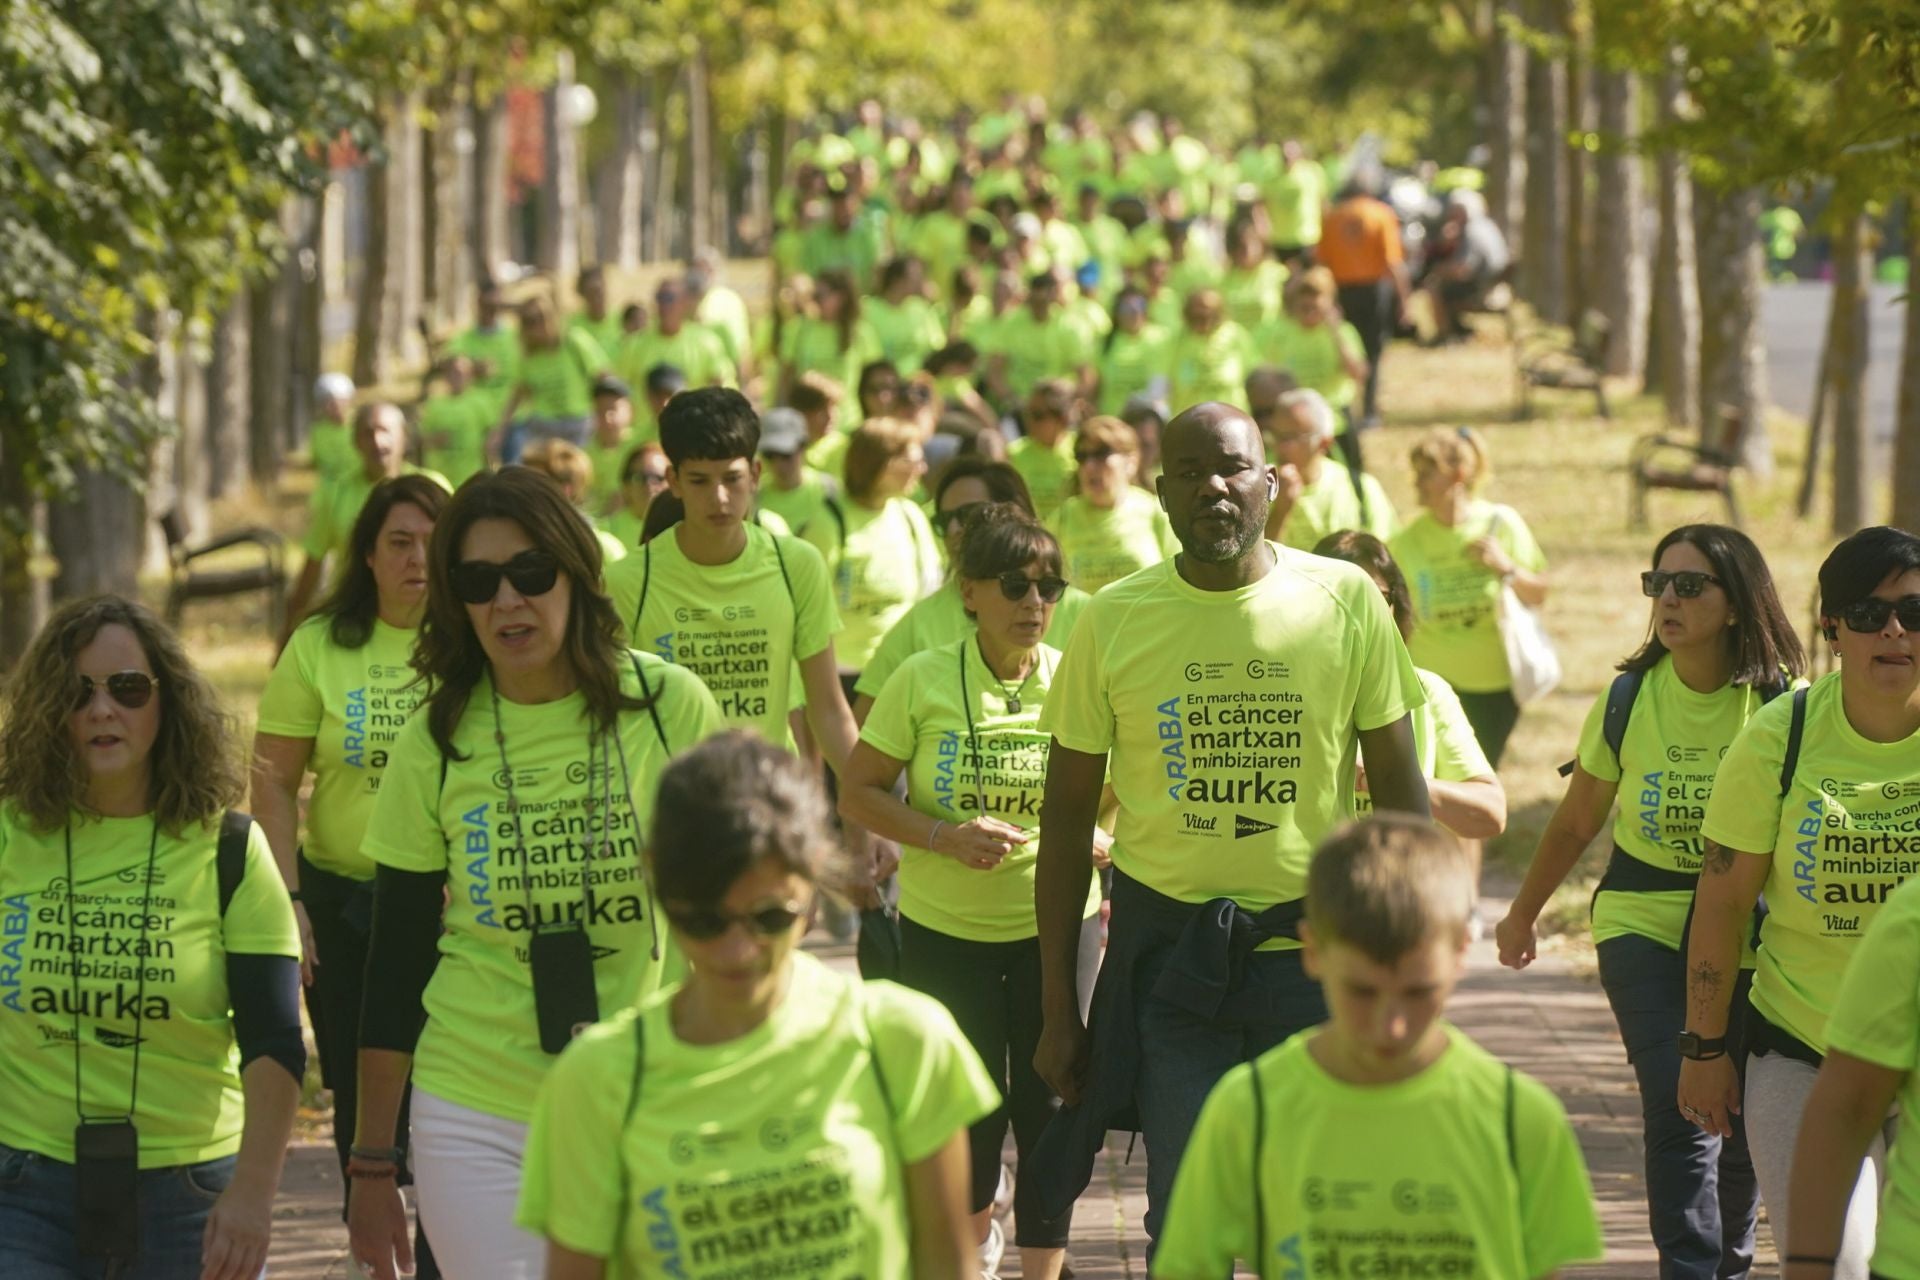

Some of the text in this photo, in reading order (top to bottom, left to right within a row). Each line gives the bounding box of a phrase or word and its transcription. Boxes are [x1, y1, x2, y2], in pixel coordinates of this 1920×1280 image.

[677, 628, 767, 641] En marcha contra
[678, 642, 697, 658] el
[702, 640, 768, 657] cáncer
[706, 677, 769, 691] biziaren
[371, 696, 390, 710] el
[721, 691, 767, 717] rka
[1187, 691, 1303, 705] En marcha contra
[1188, 704, 1303, 726] el cáncer
[344, 687, 367, 769] ARABA
[1190, 727, 1302, 750] martxan
[964, 735, 1049, 754] el cánce
[1157, 696, 1188, 801] ARABA
[934, 730, 960, 812] ARABA
[962, 752, 1045, 772] martxa
[1192, 752, 1301, 769] minbiziaren
[960, 773, 1043, 789] mnbiziar
[1186, 771, 1298, 804] aurka
[1668, 771, 1715, 783] En marc
[1667, 783, 1688, 800] el
[520, 798, 577, 814] marcha
[960, 790, 1043, 816] aurk
[1639, 771, 1664, 842] RABA
[1894, 801, 1920, 816] con
[532, 812, 633, 836] cáncer
[1183, 812, 1218, 830] Vital
[1825, 813, 1920, 833] el cánc
[497, 838, 638, 866] martxan
[1794, 800, 1823, 904] ARABA
[1825, 832, 1920, 854] martxa
[462, 803, 503, 928] ARABA
[1674, 856, 1704, 869] Vita
[1823, 857, 1920, 874] minbiziar
[497, 866, 642, 891] mnbiziaren
[64, 893, 121, 905] marcha
[126, 895, 176, 909] contra
[1824, 876, 1905, 904] aur
[38, 904, 175, 931] el cáncer
[503, 890, 644, 931] aurka
[1823, 914, 1860, 931] Vital
[0, 895, 30, 1013] ARABA
[34, 930, 174, 959] martxan
[30, 956, 176, 983] minbiziaren
[30, 983, 170, 1020] aurka
